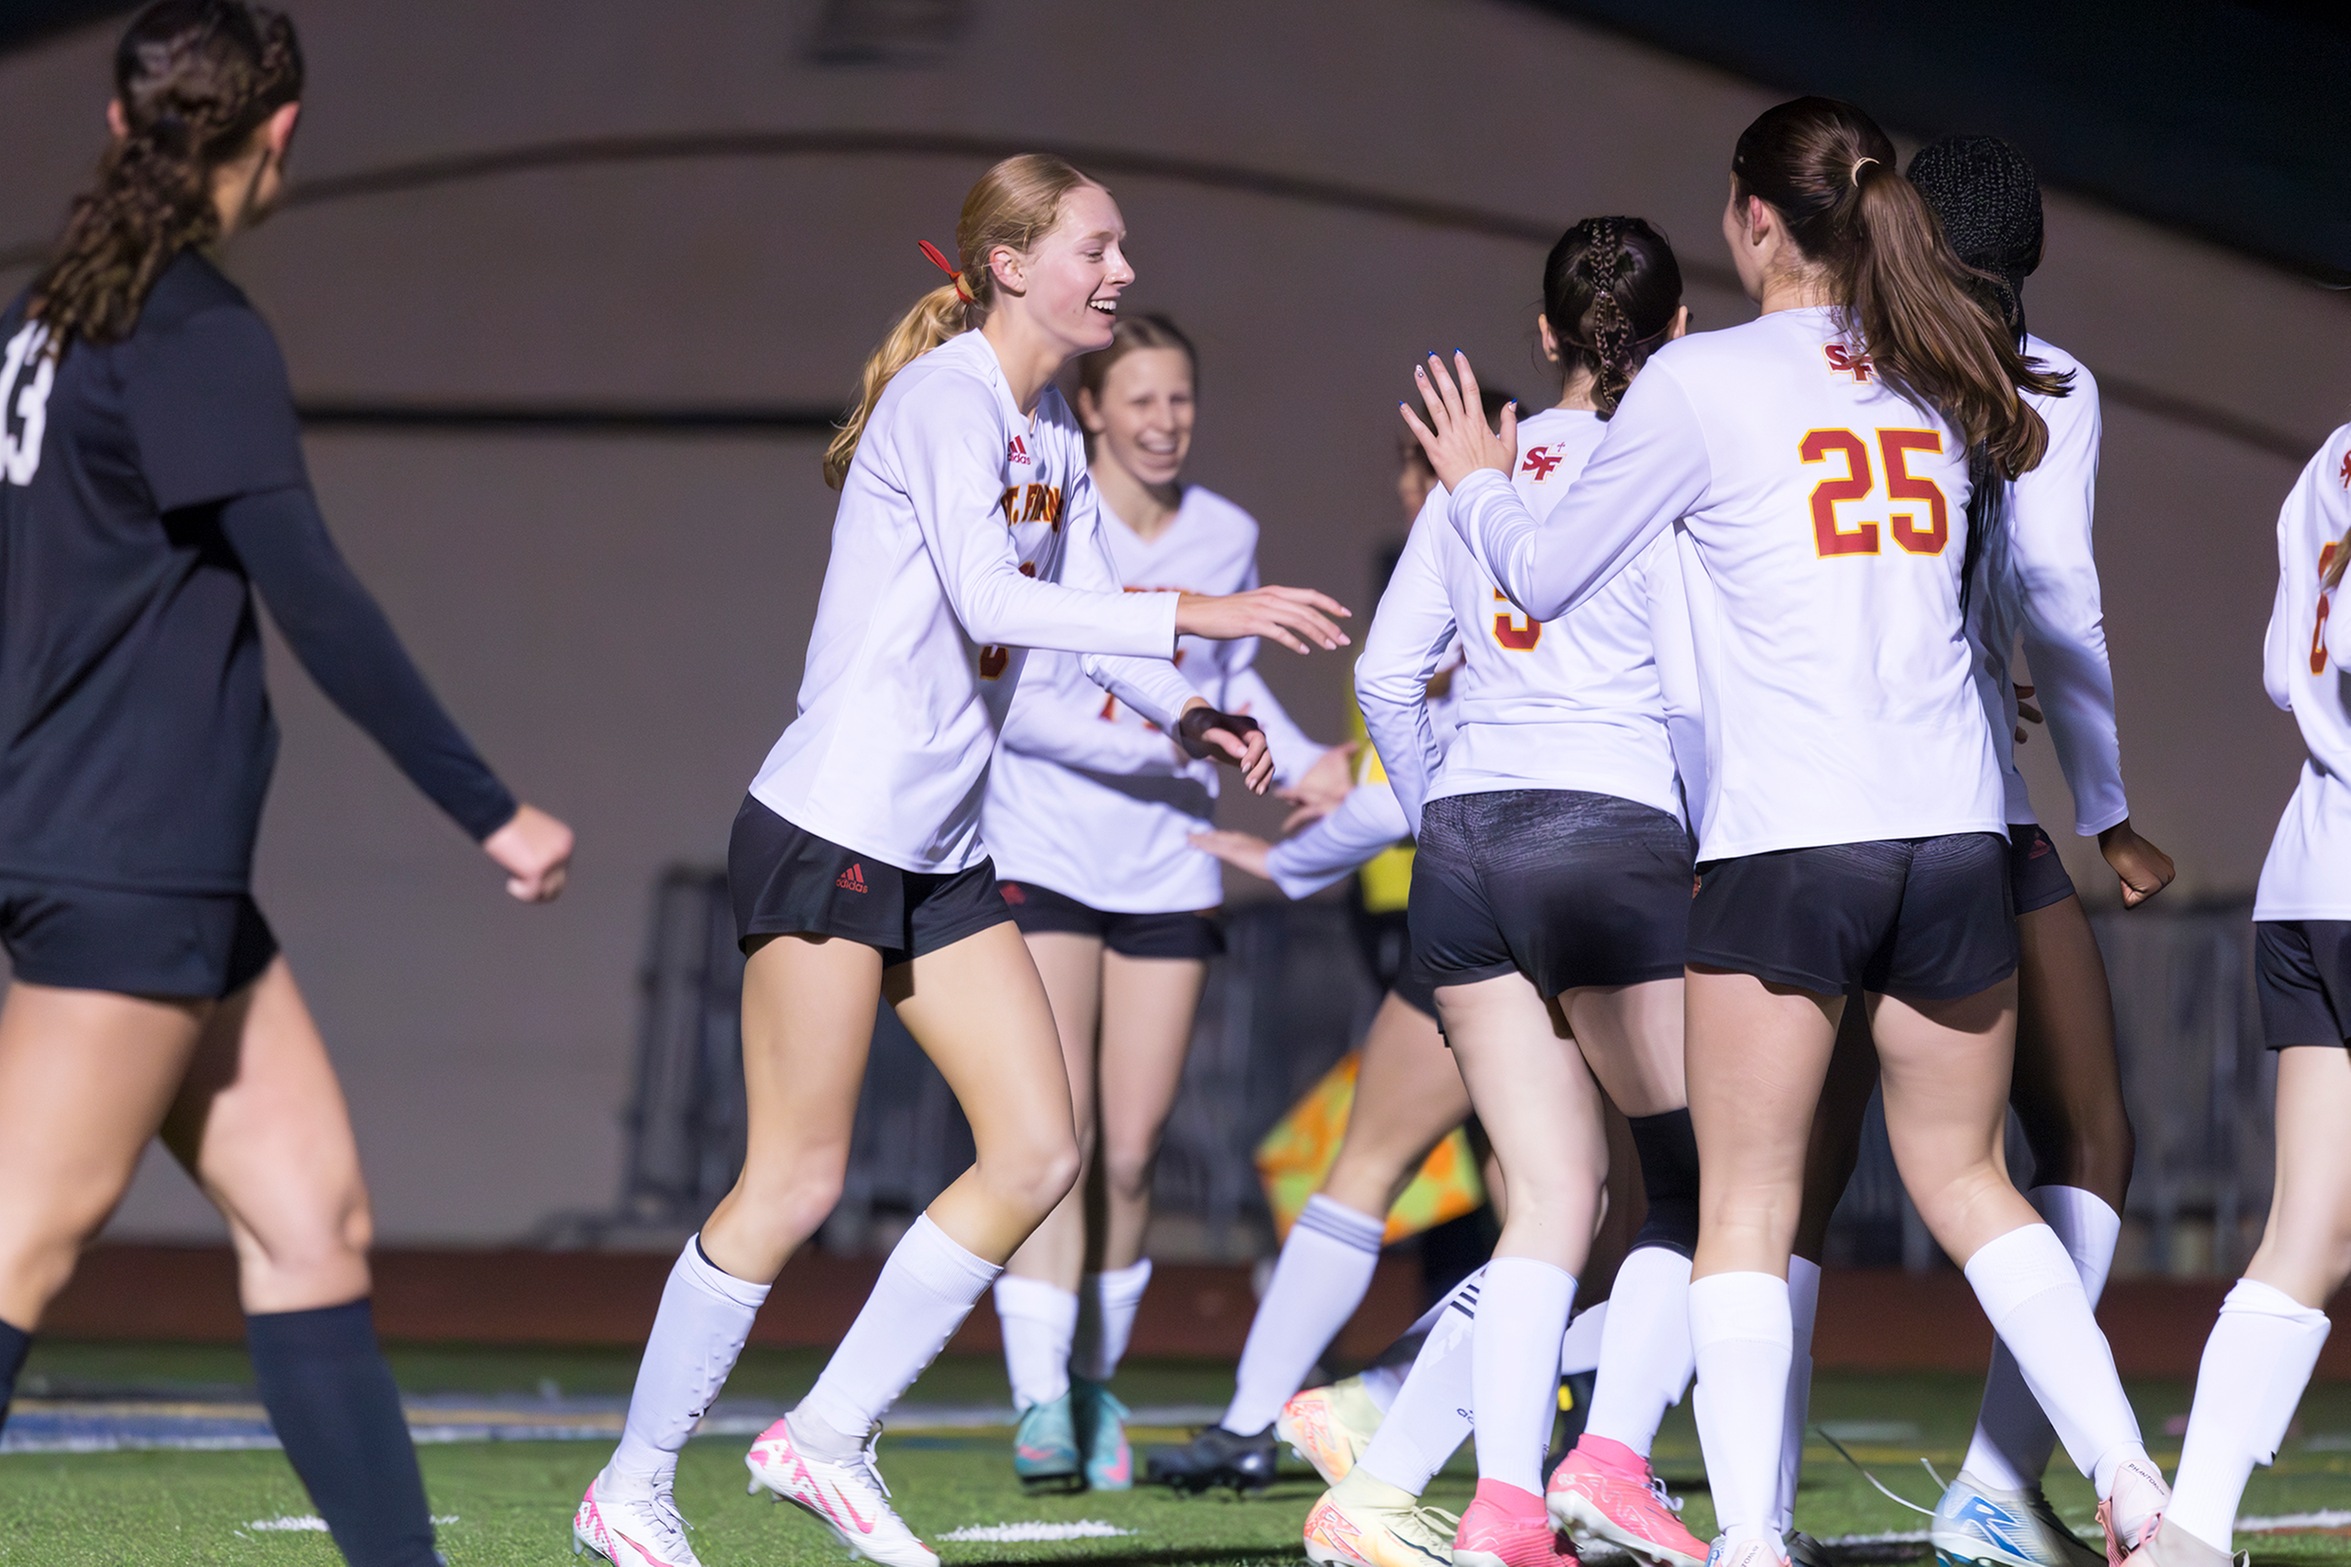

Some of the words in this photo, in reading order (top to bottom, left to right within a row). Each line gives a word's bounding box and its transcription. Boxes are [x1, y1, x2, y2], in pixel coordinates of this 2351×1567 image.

[1822, 343, 1879, 384] SF
[1518, 446, 1567, 484] SF
[1798, 427, 1949, 559] 25
[836, 879, 868, 894] adidas
